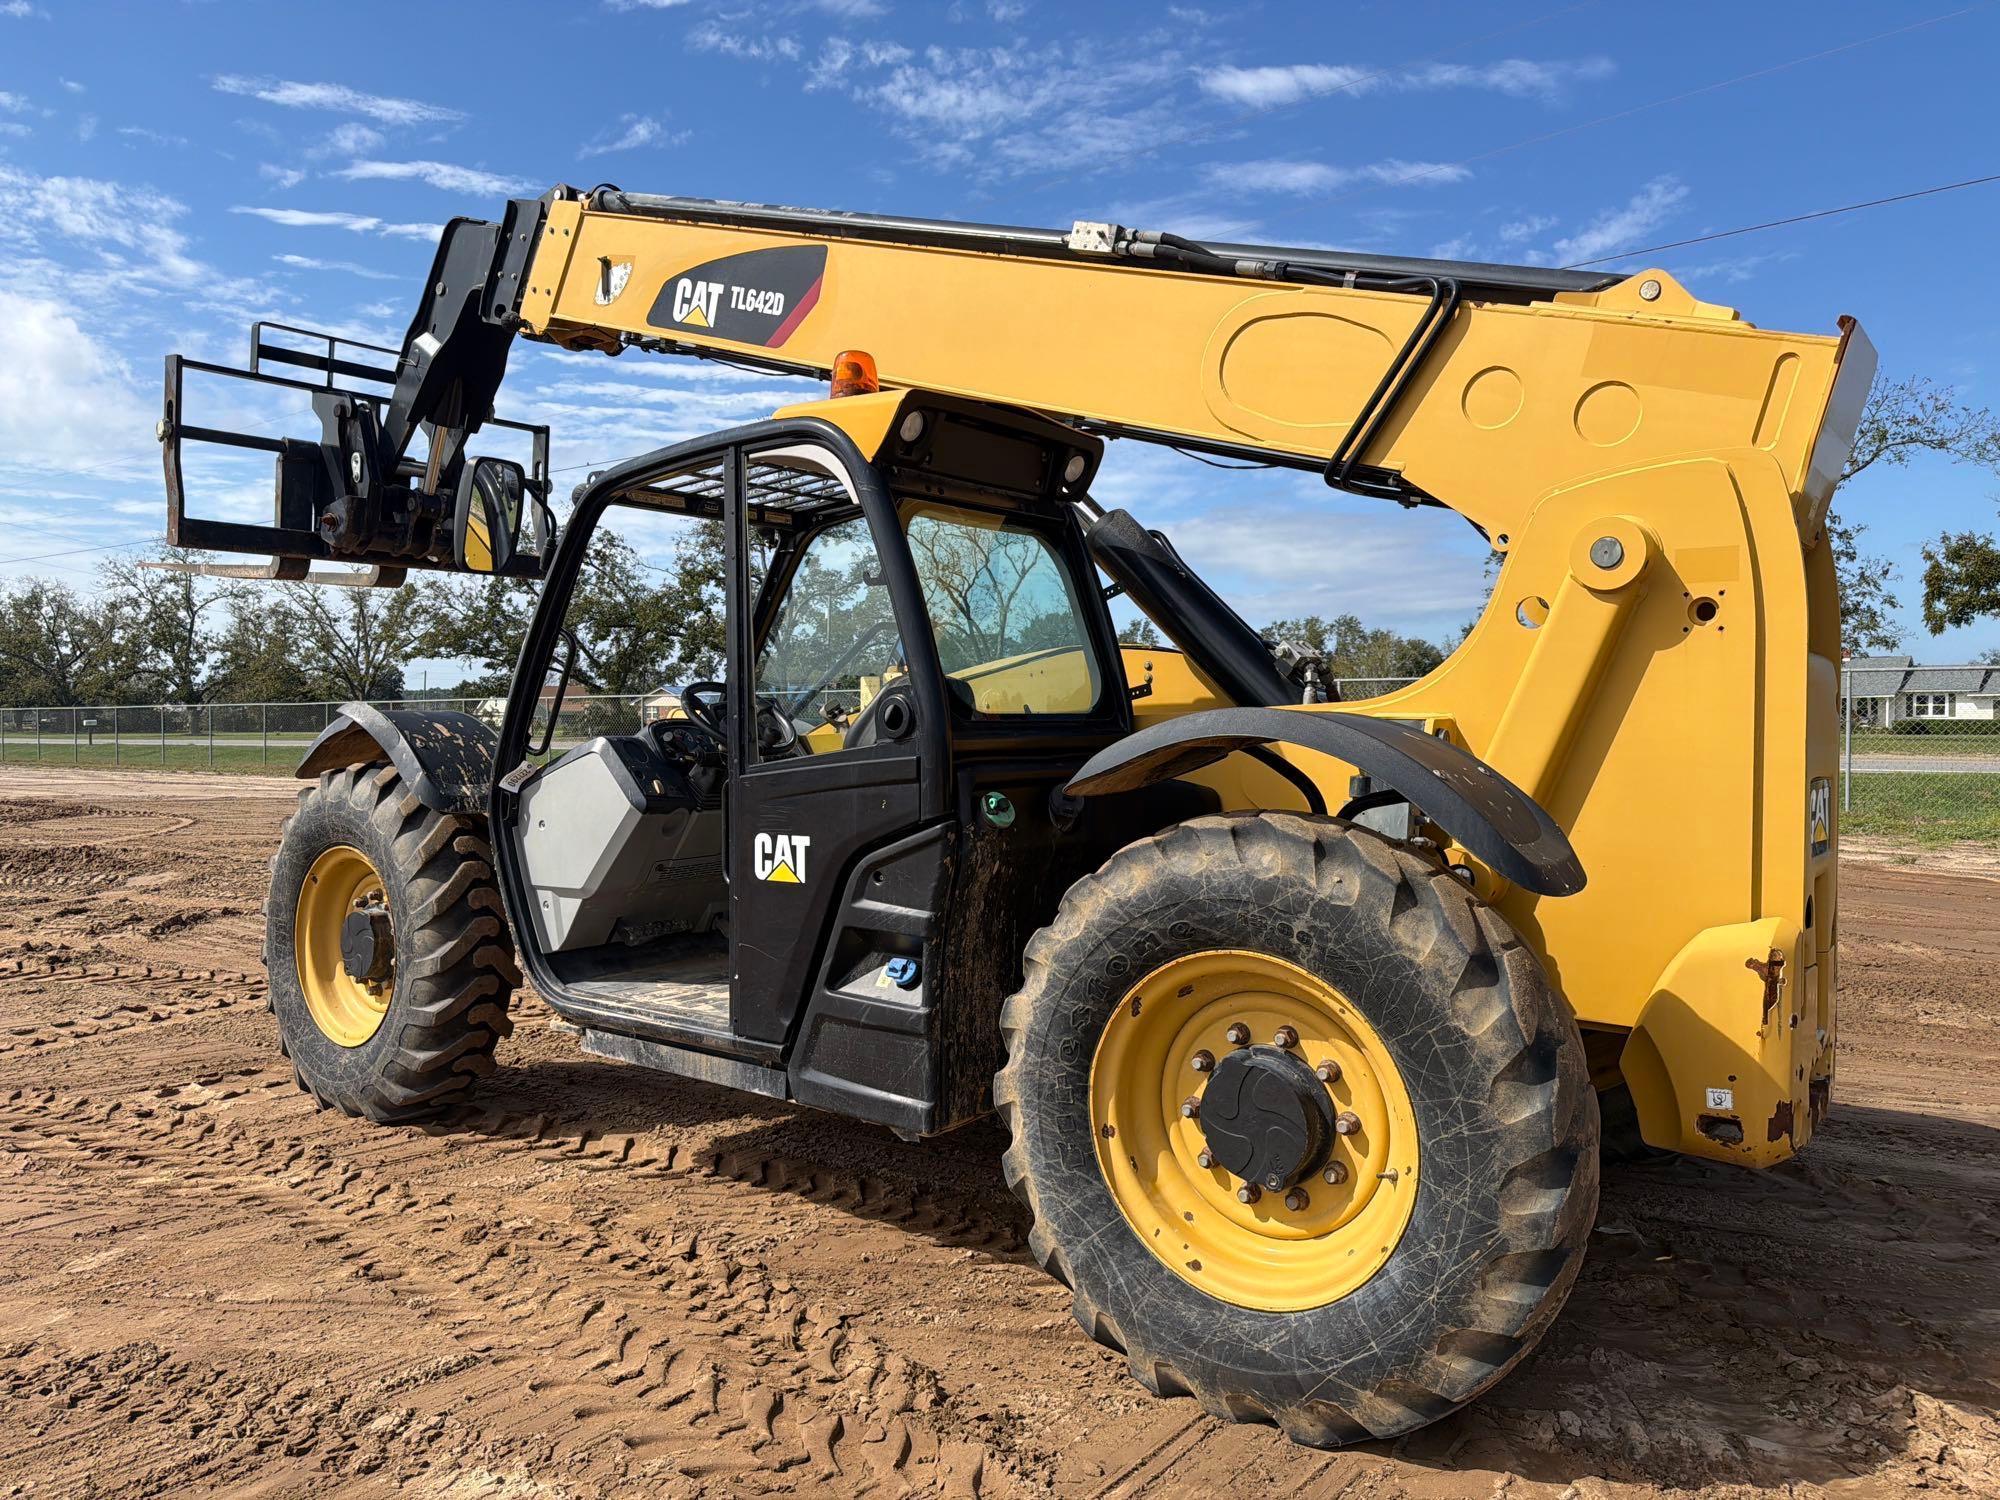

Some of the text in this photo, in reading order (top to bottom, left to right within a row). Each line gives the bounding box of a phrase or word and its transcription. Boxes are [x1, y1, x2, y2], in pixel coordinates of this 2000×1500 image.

[672, 277, 785, 328] CAT TL642D
[1809, 783, 1830, 849] CAT
[754, 832, 811, 884] CAT
